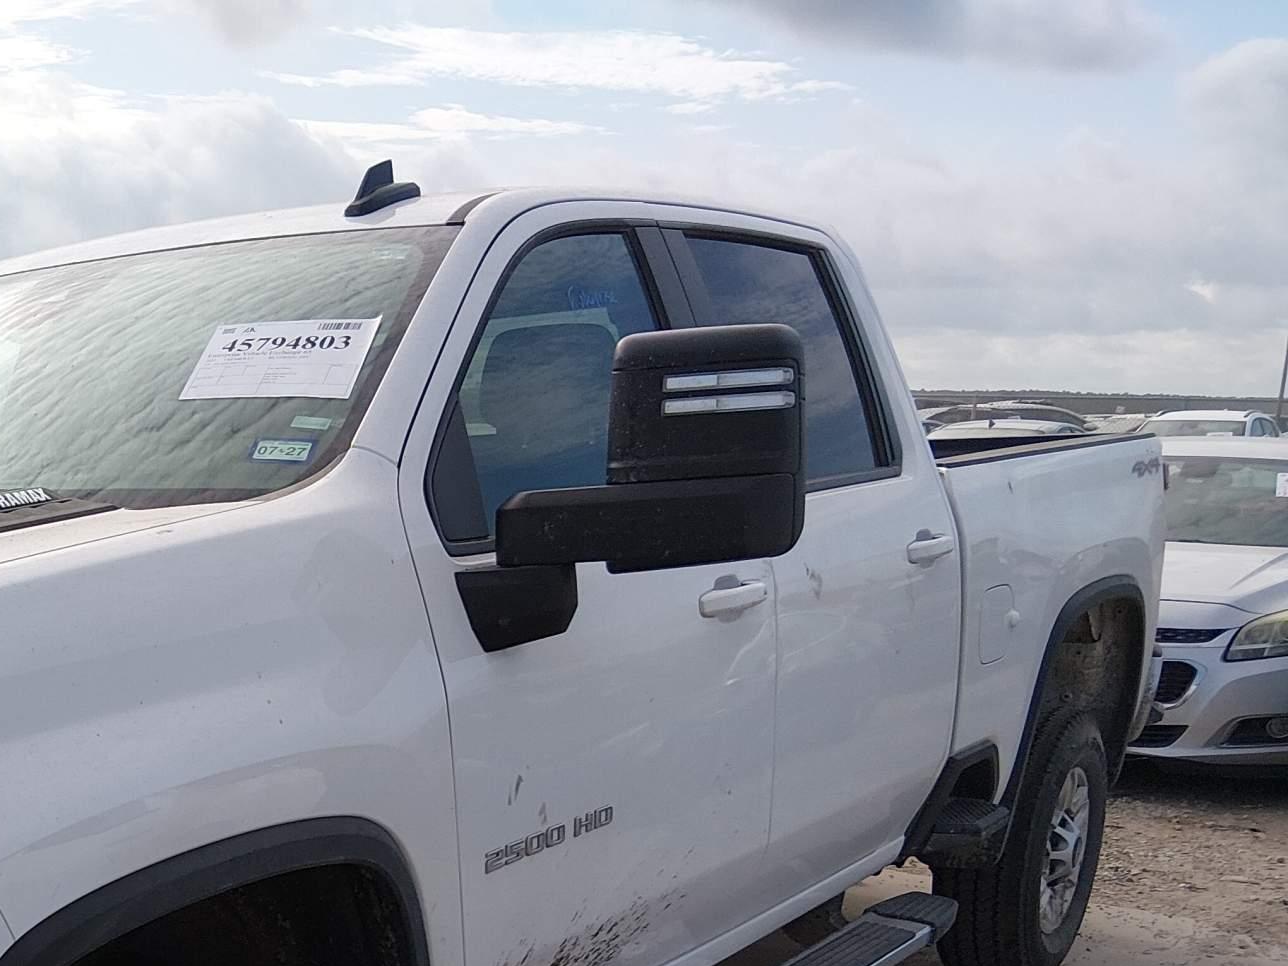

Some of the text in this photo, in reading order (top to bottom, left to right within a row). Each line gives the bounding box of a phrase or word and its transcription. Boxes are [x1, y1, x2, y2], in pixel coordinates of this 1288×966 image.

[222, 335, 352, 353] 45794803
[484, 804, 614, 875] 2500 HD
